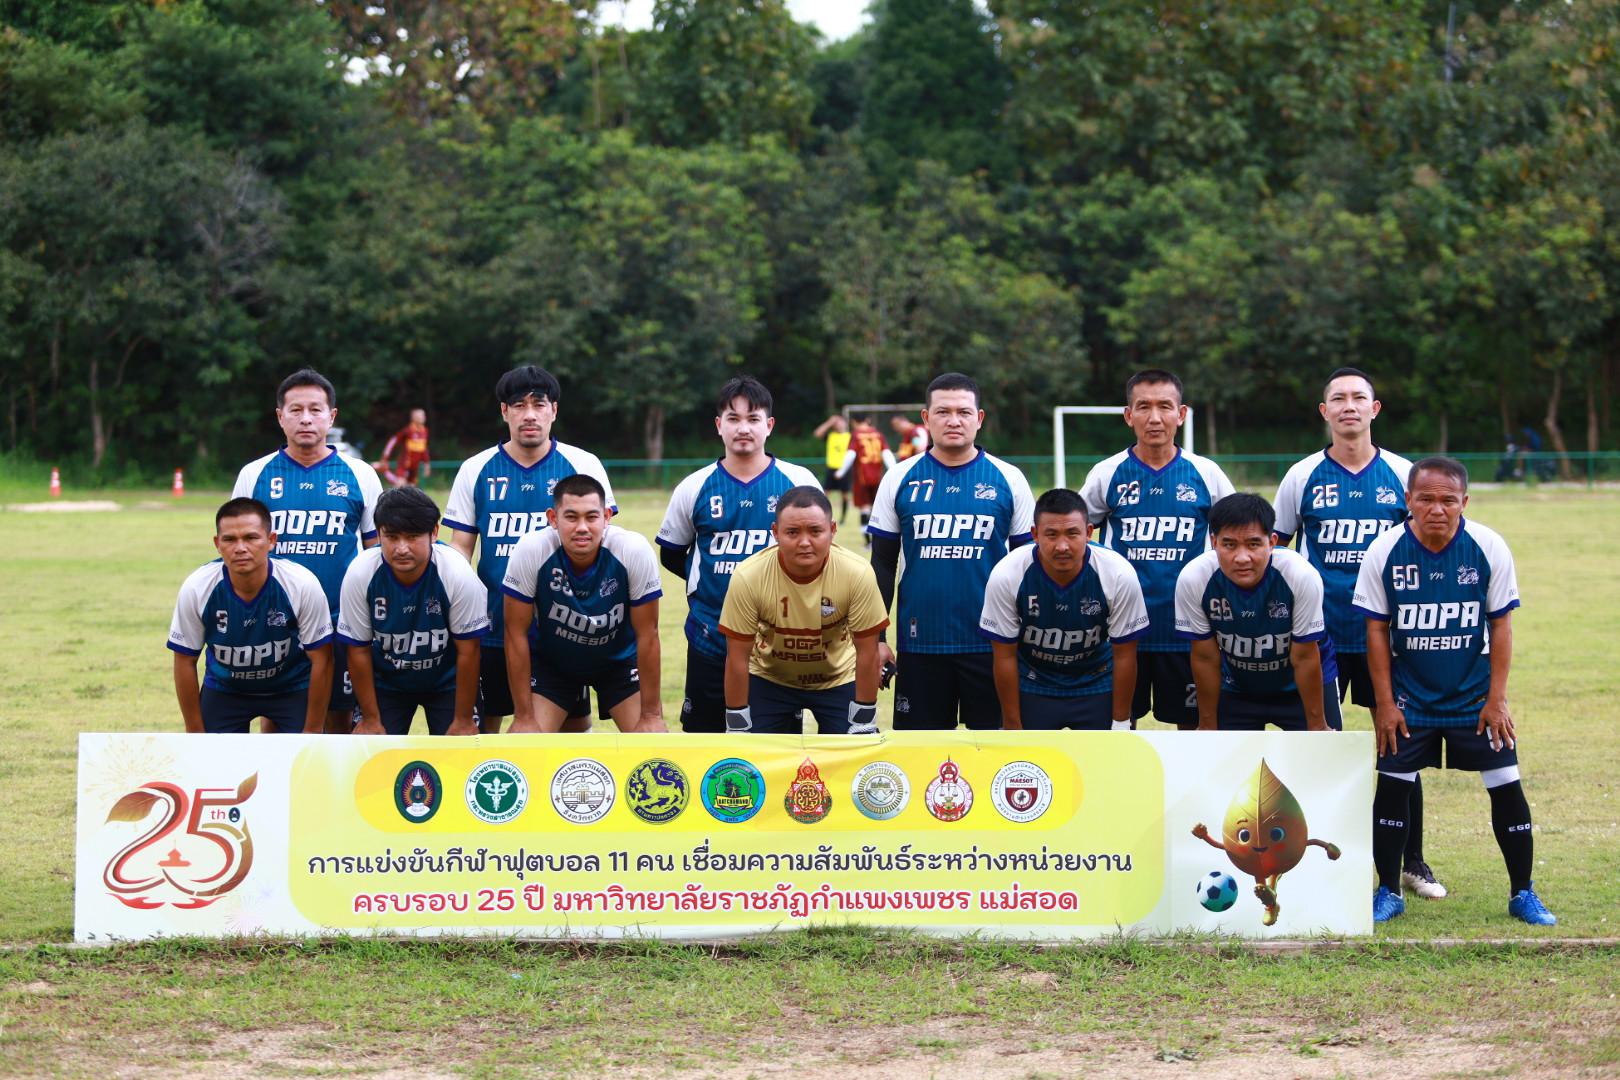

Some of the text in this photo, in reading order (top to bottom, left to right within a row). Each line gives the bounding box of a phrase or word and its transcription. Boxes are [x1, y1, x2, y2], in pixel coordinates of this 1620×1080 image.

[270, 477, 284, 499] 9
[487, 477, 509, 501] 17
[908, 479, 936, 503] 77
[1117, 480, 1140, 506] 23
[1312, 484, 1339, 509] 25
[270, 510, 348, 535] DOPA
[487, 512, 549, 538] DOP
[913, 514, 996, 540] DOPA
[1120, 516, 1195, 541] DOPA
[275, 541, 339, 555] MAESOT
[709, 529, 778, 556] DOP
[920, 545, 985, 560] MAESOT
[1127, 547, 1187, 561] MAESOT
[1392, 564, 1420, 591] 50
[374, 597, 387, 621] 6
[547, 600, 625, 635] DOPA
[780, 596, 789, 618] 1
[1397, 601, 1481, 630] DOPA
[215, 610, 229, 634] 3
[555, 626, 619, 646] MAESOT
[1023, 625, 1103, 651] DOPA
[1406, 635, 1473, 651] MAESOT
[213, 638, 292, 667] DOPA
[1379, 818, 1404, 828] EGO
[1508, 823, 1531, 833] EGO
[308, 838, 1132, 881] การแข่งขันกีฬาฟุตบอล 11 คน เชื่อมความสัมพันธ์ระหว่างหน่วยงาน
[354, 893, 469, 913] ครบรอบ
[477, 889, 515, 912] 25
[523, 883, 545, 912] ปี
[980, 883, 1078, 910] แม่สอด
